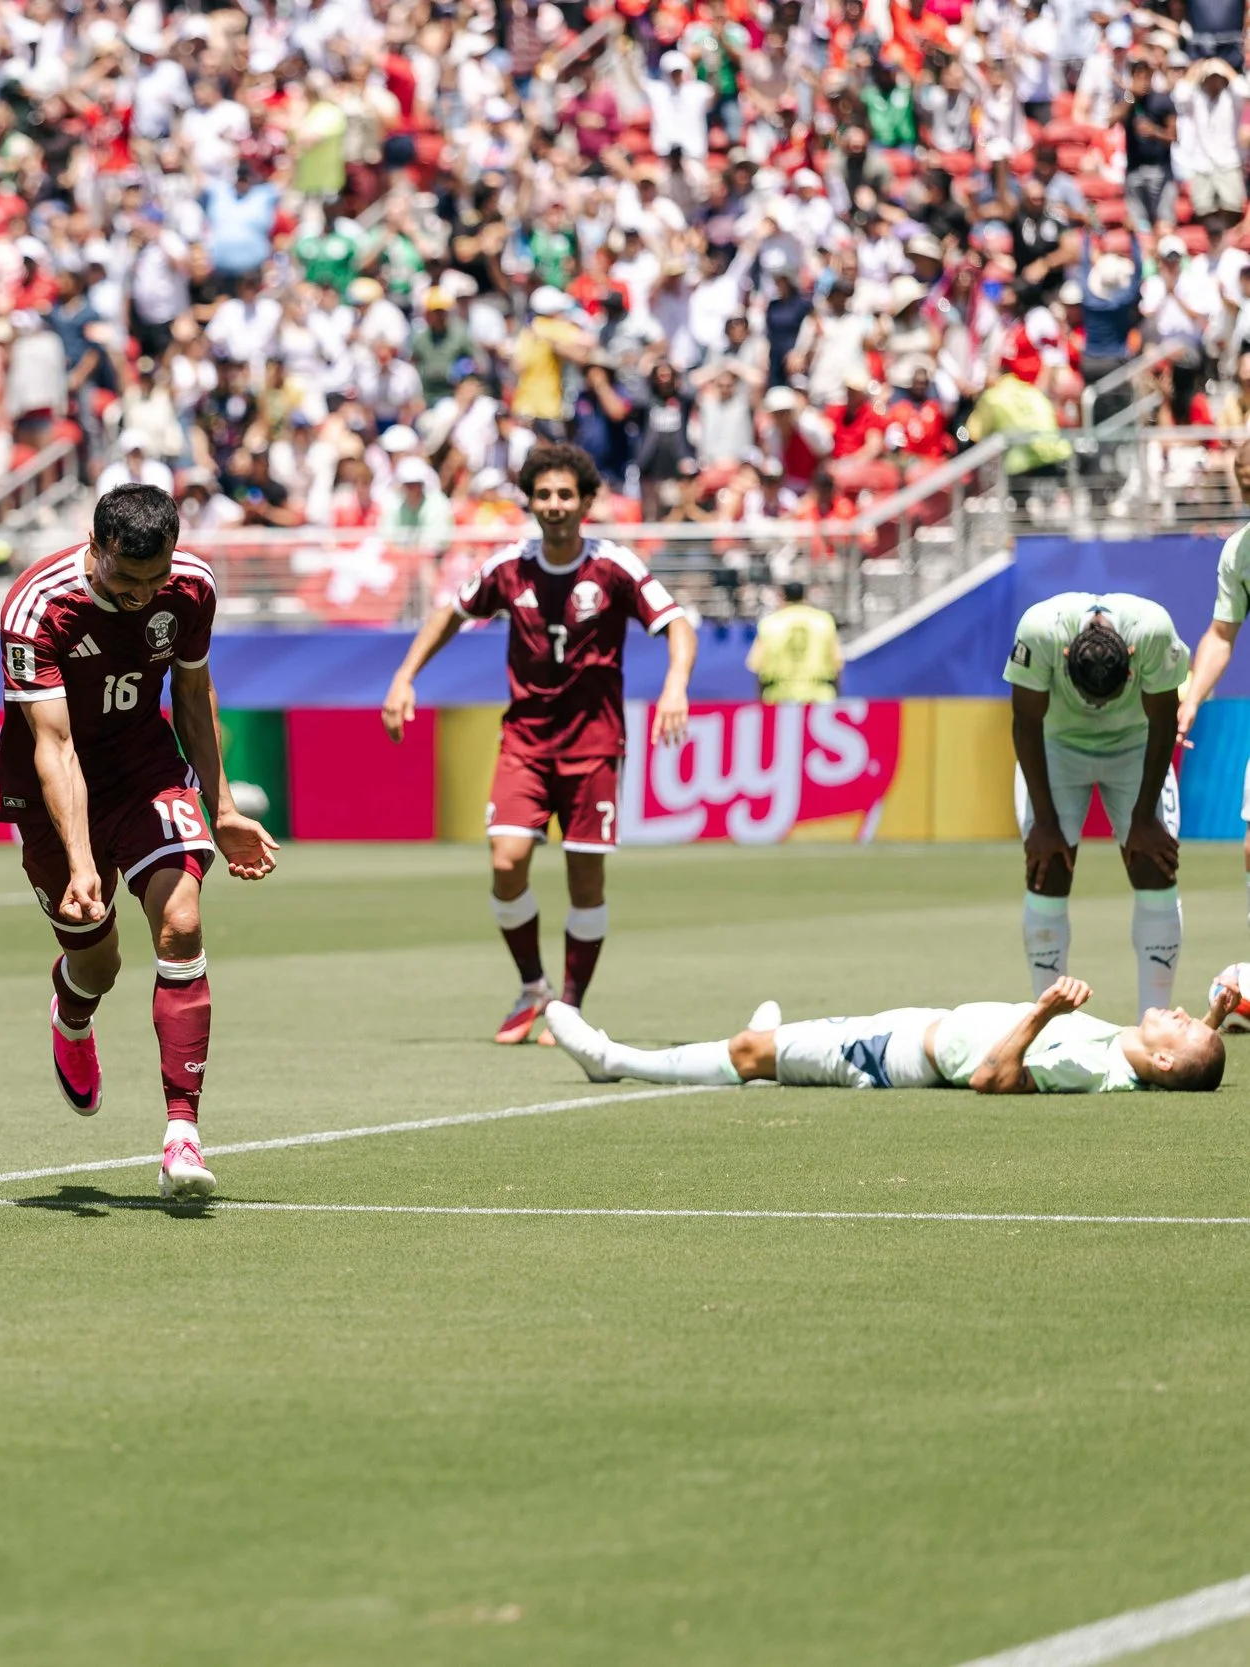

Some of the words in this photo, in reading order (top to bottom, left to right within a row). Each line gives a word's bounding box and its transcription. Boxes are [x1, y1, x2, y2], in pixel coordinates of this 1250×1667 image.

[547, 624, 568, 664] 7
[102, 671, 143, 714] 16
[153, 799, 202, 840] 16
[595, 800, 616, 842] 7
